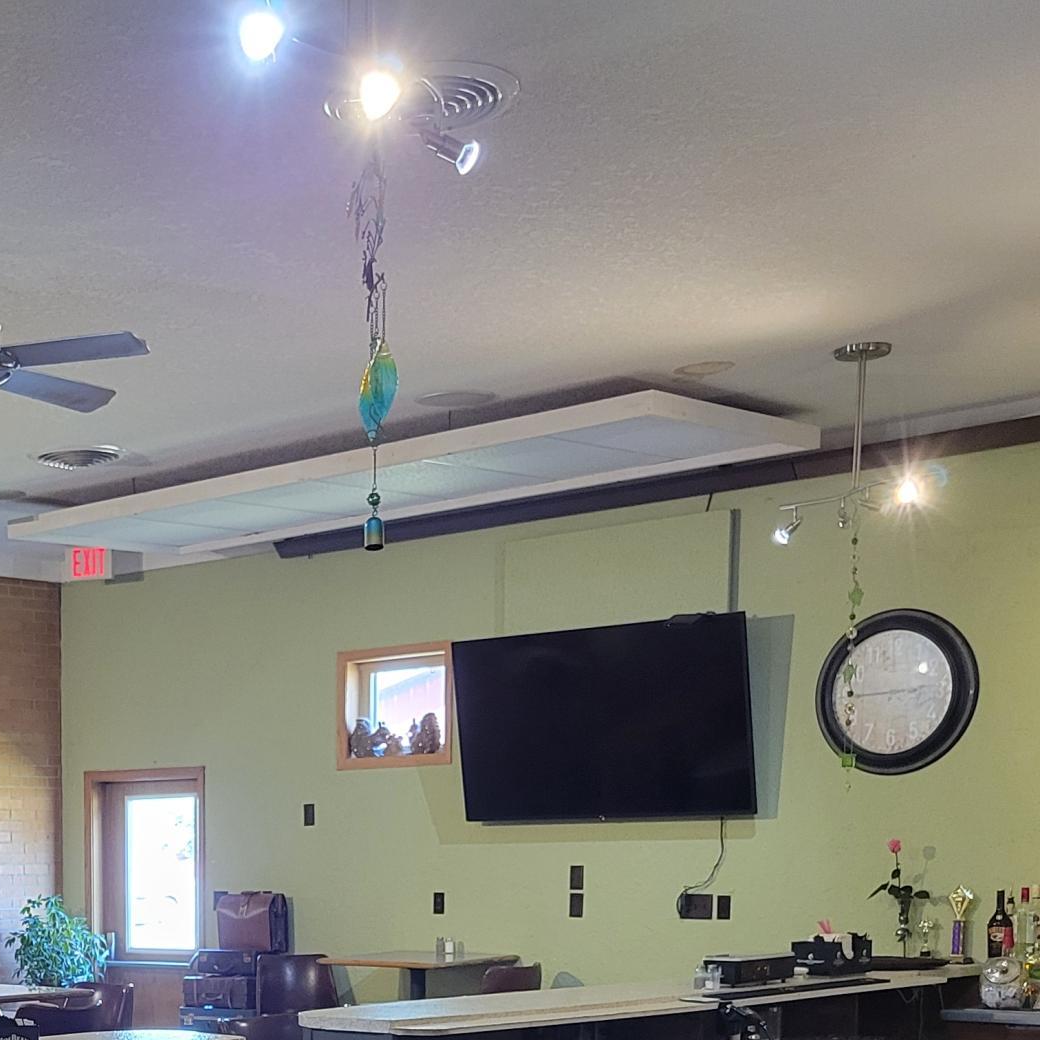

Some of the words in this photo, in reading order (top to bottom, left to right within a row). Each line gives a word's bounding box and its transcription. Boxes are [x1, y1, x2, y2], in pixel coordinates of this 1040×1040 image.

[72, 547, 106, 577] EXIT
[862, 723, 874, 746] 7
[886, 728, 896, 747] 6
